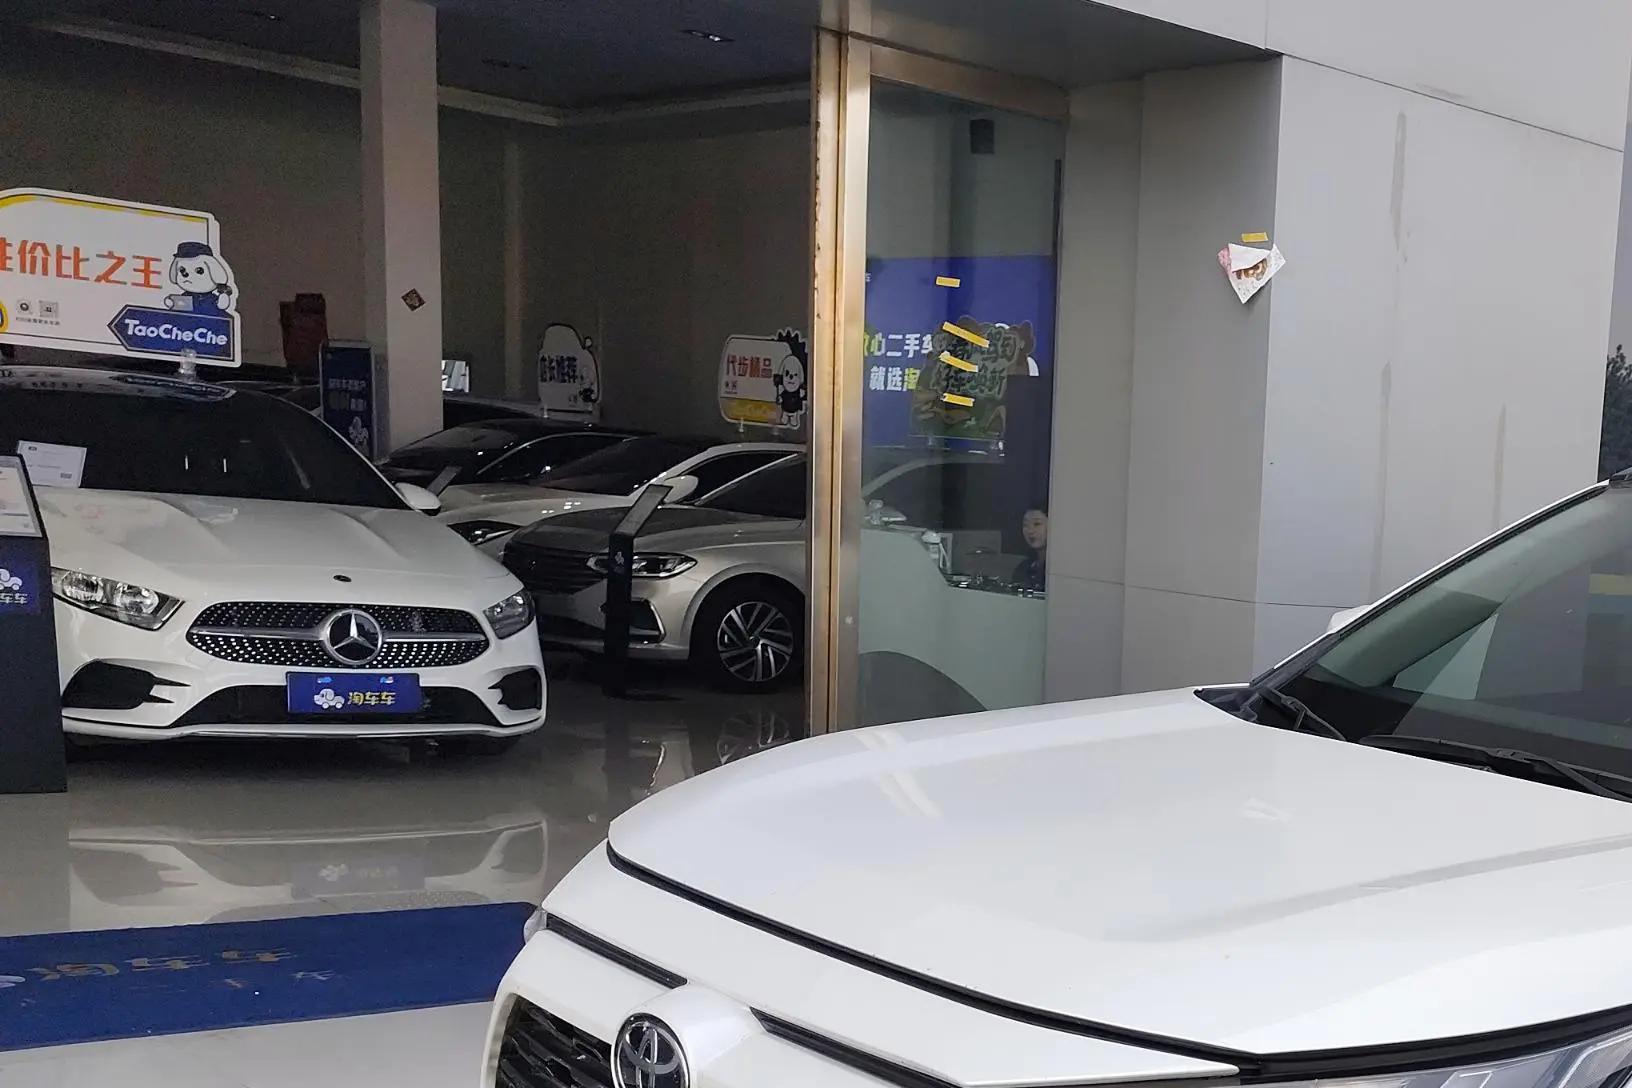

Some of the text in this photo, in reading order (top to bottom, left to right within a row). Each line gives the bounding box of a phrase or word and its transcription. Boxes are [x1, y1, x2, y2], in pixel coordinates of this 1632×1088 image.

[124, 318, 228, 346] TaoCheChe
[864, 333, 932, 358] 心二手车
[348, 691, 396, 706] 淘车车
